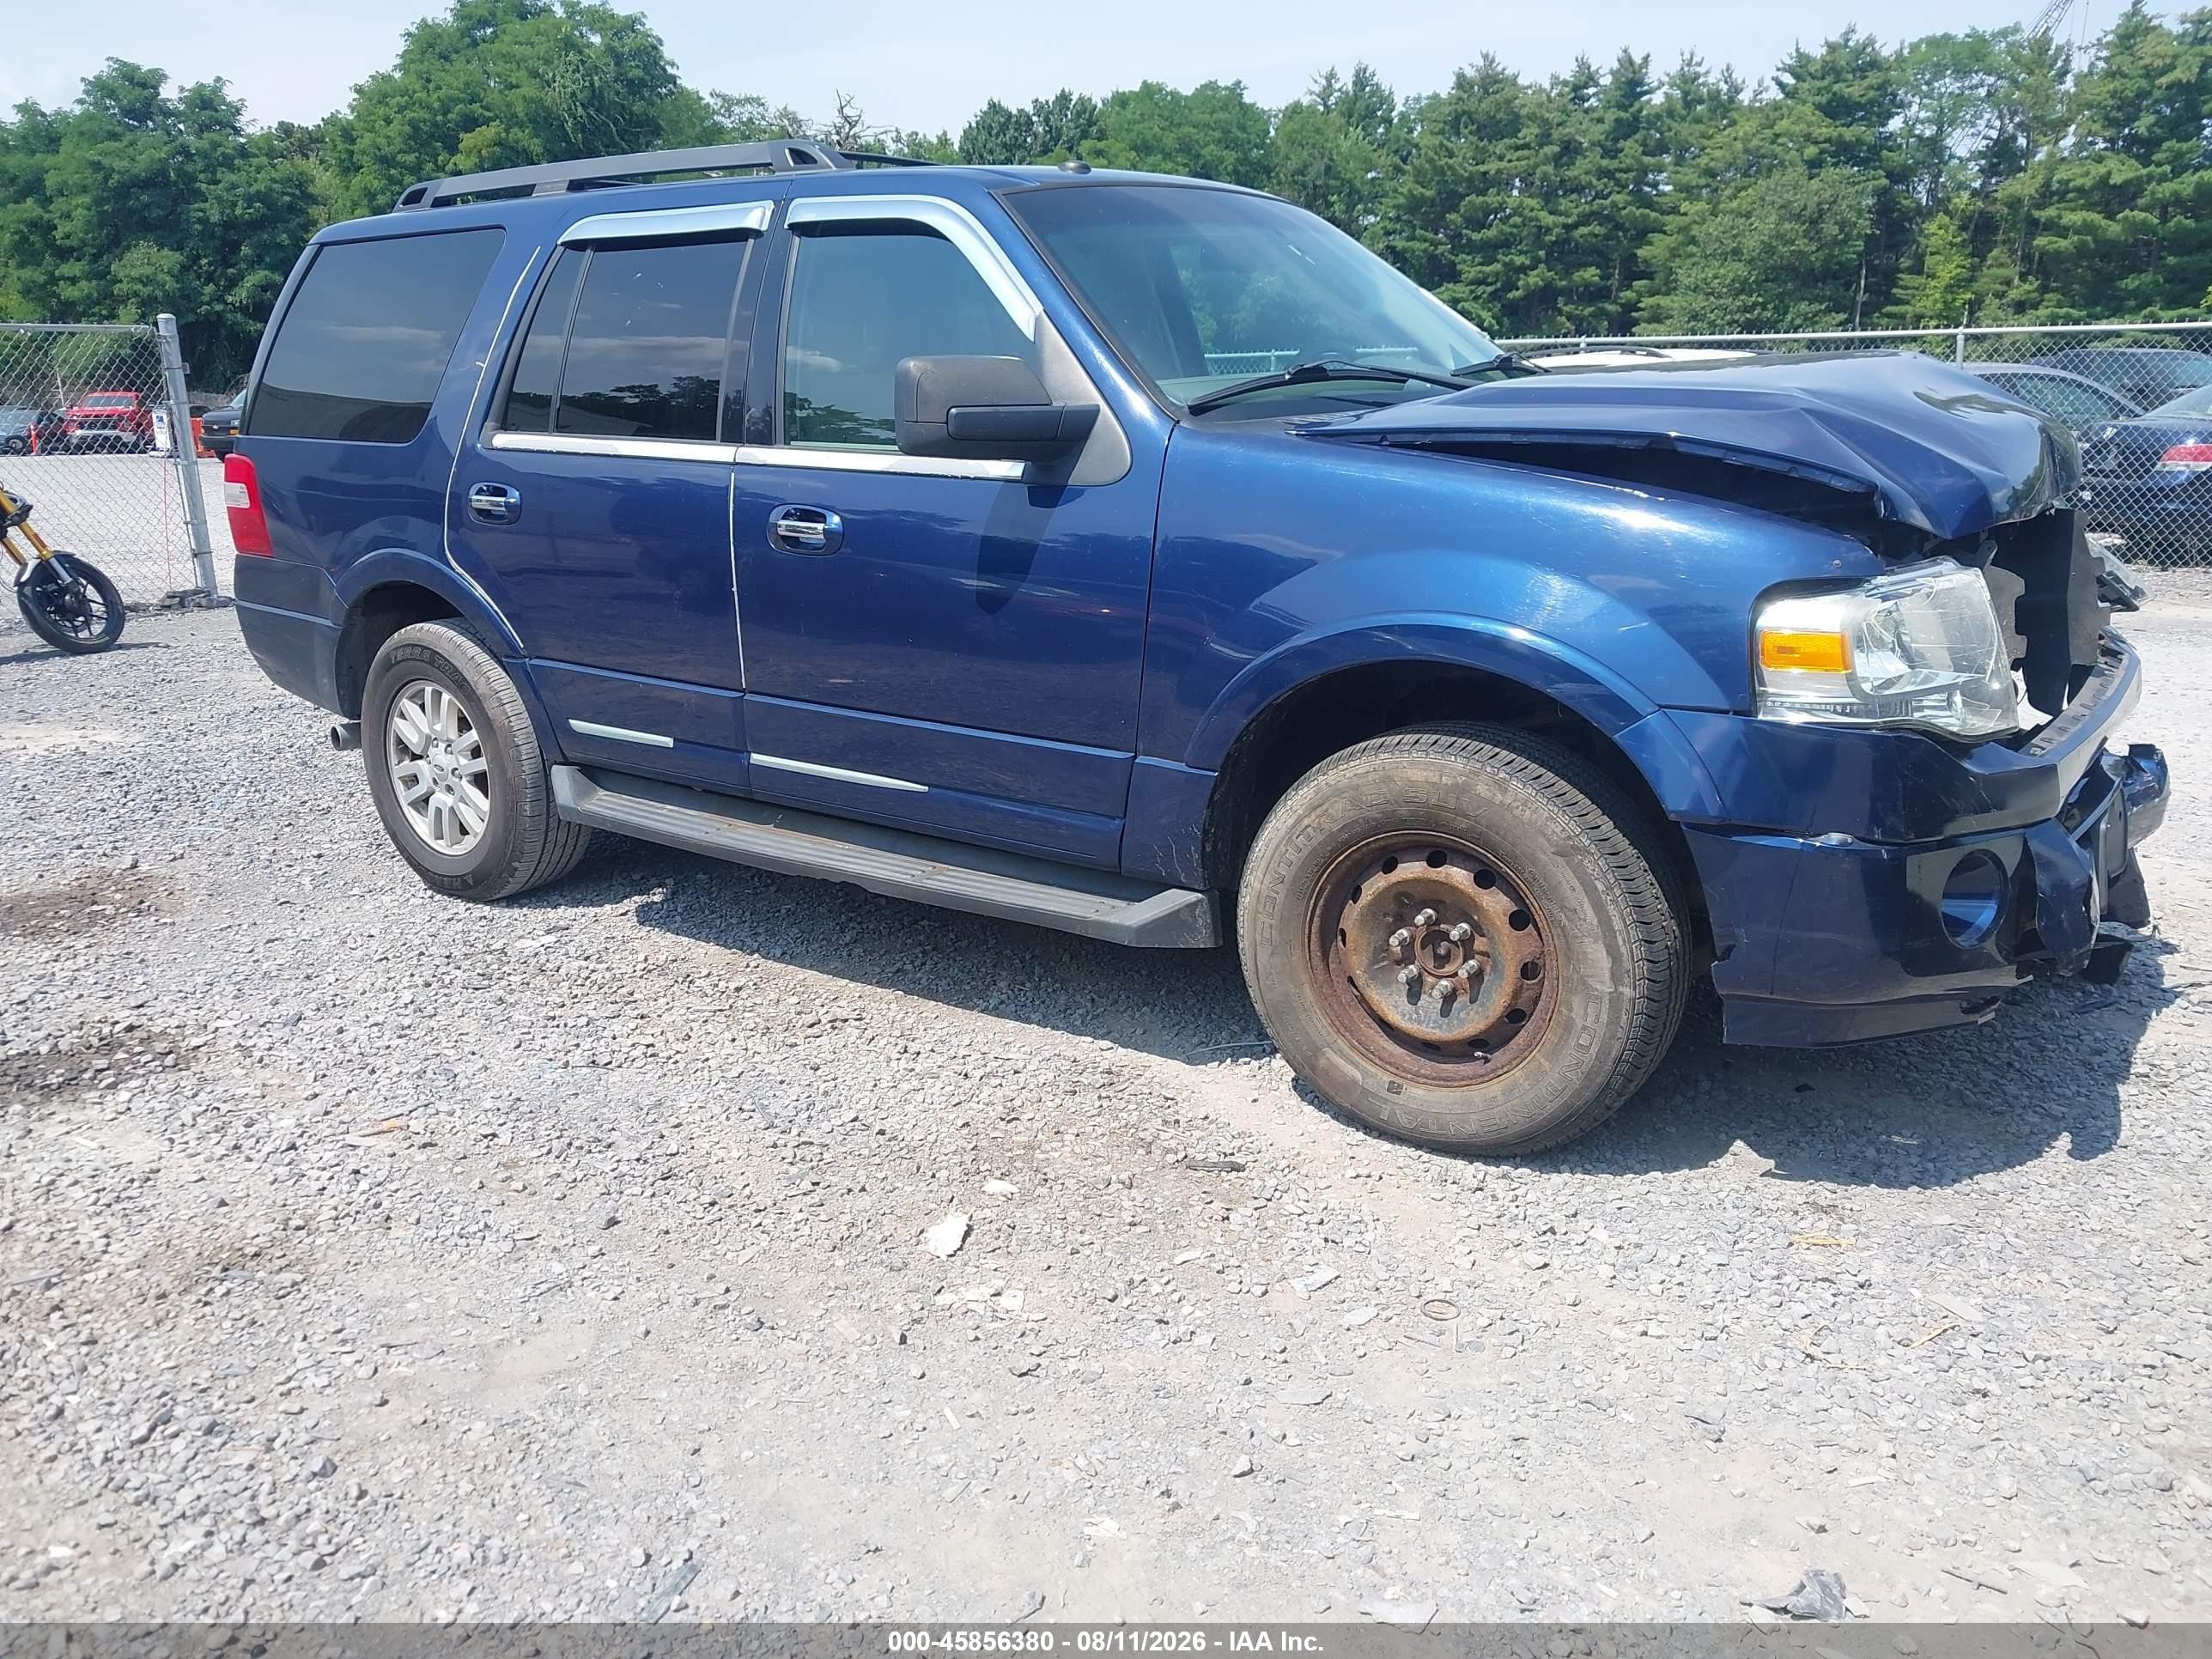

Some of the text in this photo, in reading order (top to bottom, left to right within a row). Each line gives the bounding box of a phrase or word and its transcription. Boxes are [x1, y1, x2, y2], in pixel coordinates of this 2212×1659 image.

[390, 646, 471, 694] TERRA TRAC
[1261, 789, 1389, 947] CONTITRAC
[1402, 787, 1488, 817] SUV
[1367, 992, 1602, 1136] CONTINENTAL
